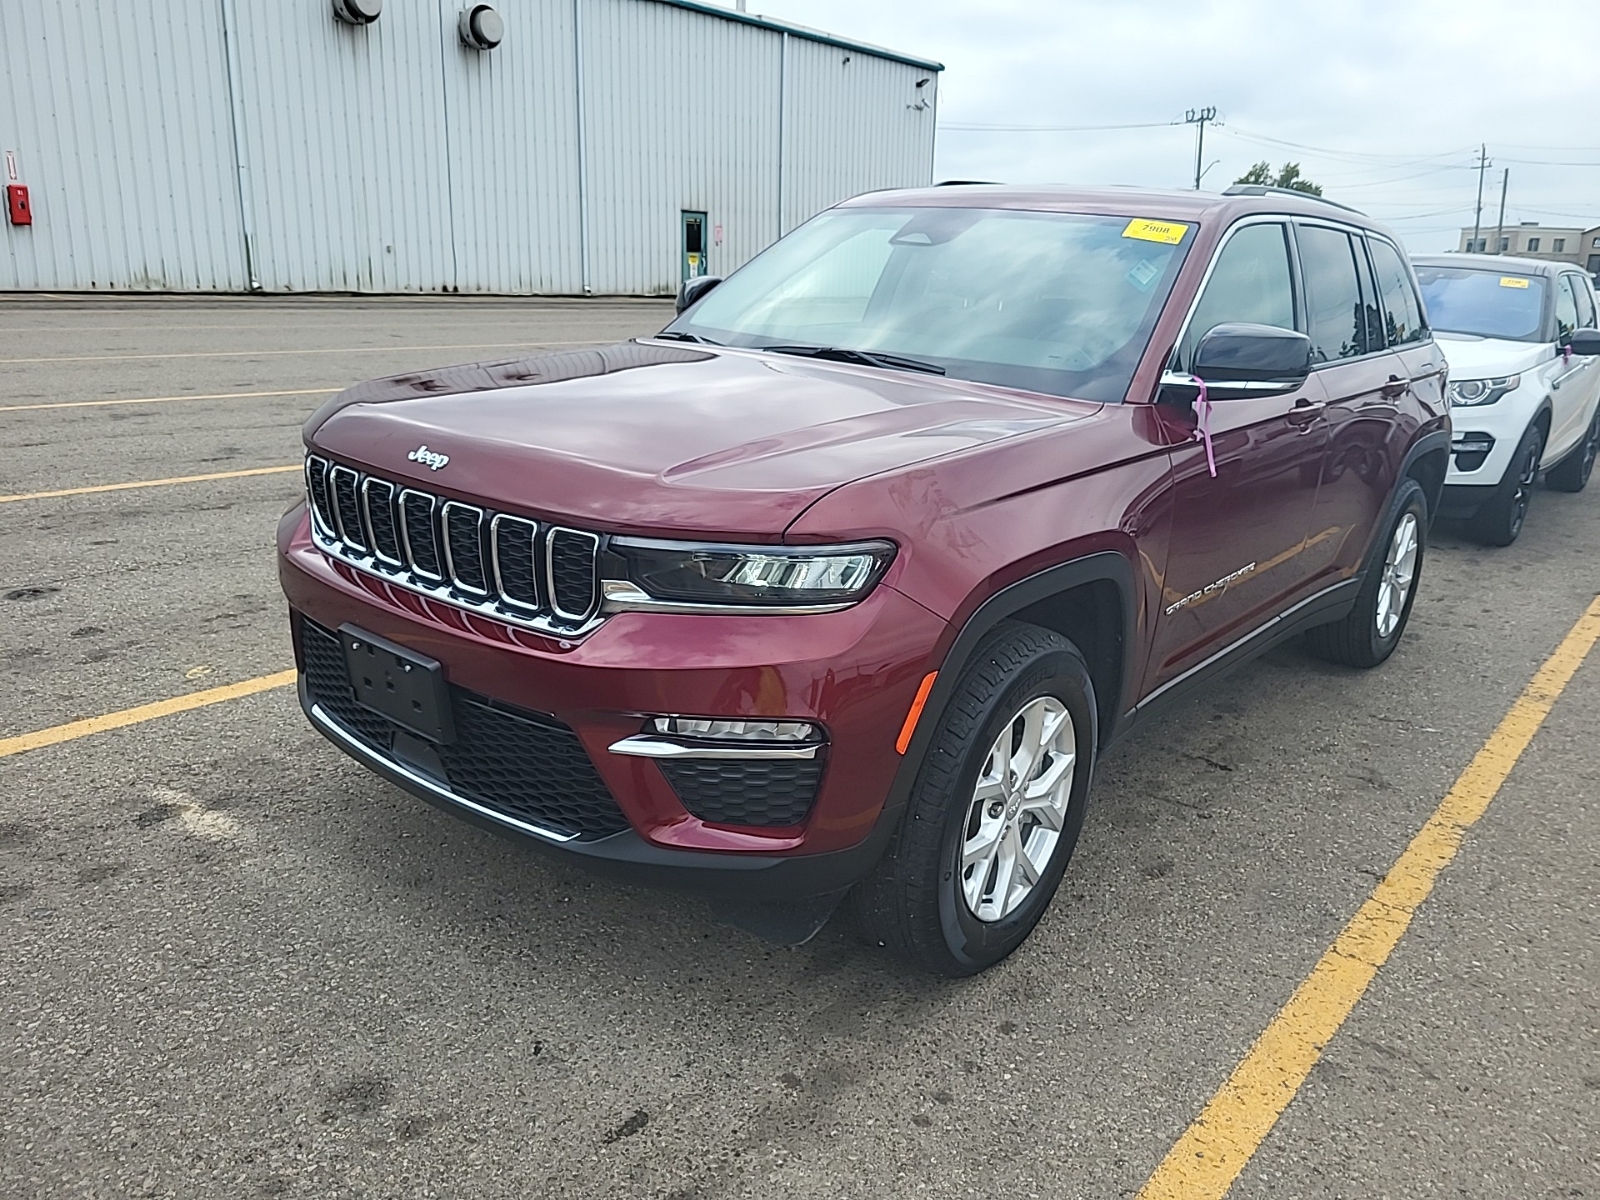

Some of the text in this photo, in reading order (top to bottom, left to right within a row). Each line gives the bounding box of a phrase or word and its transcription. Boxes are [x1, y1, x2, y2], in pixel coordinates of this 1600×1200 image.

[408, 445, 450, 471] Jeep
[1165, 561, 1256, 615] GRAND CHEROKEE
